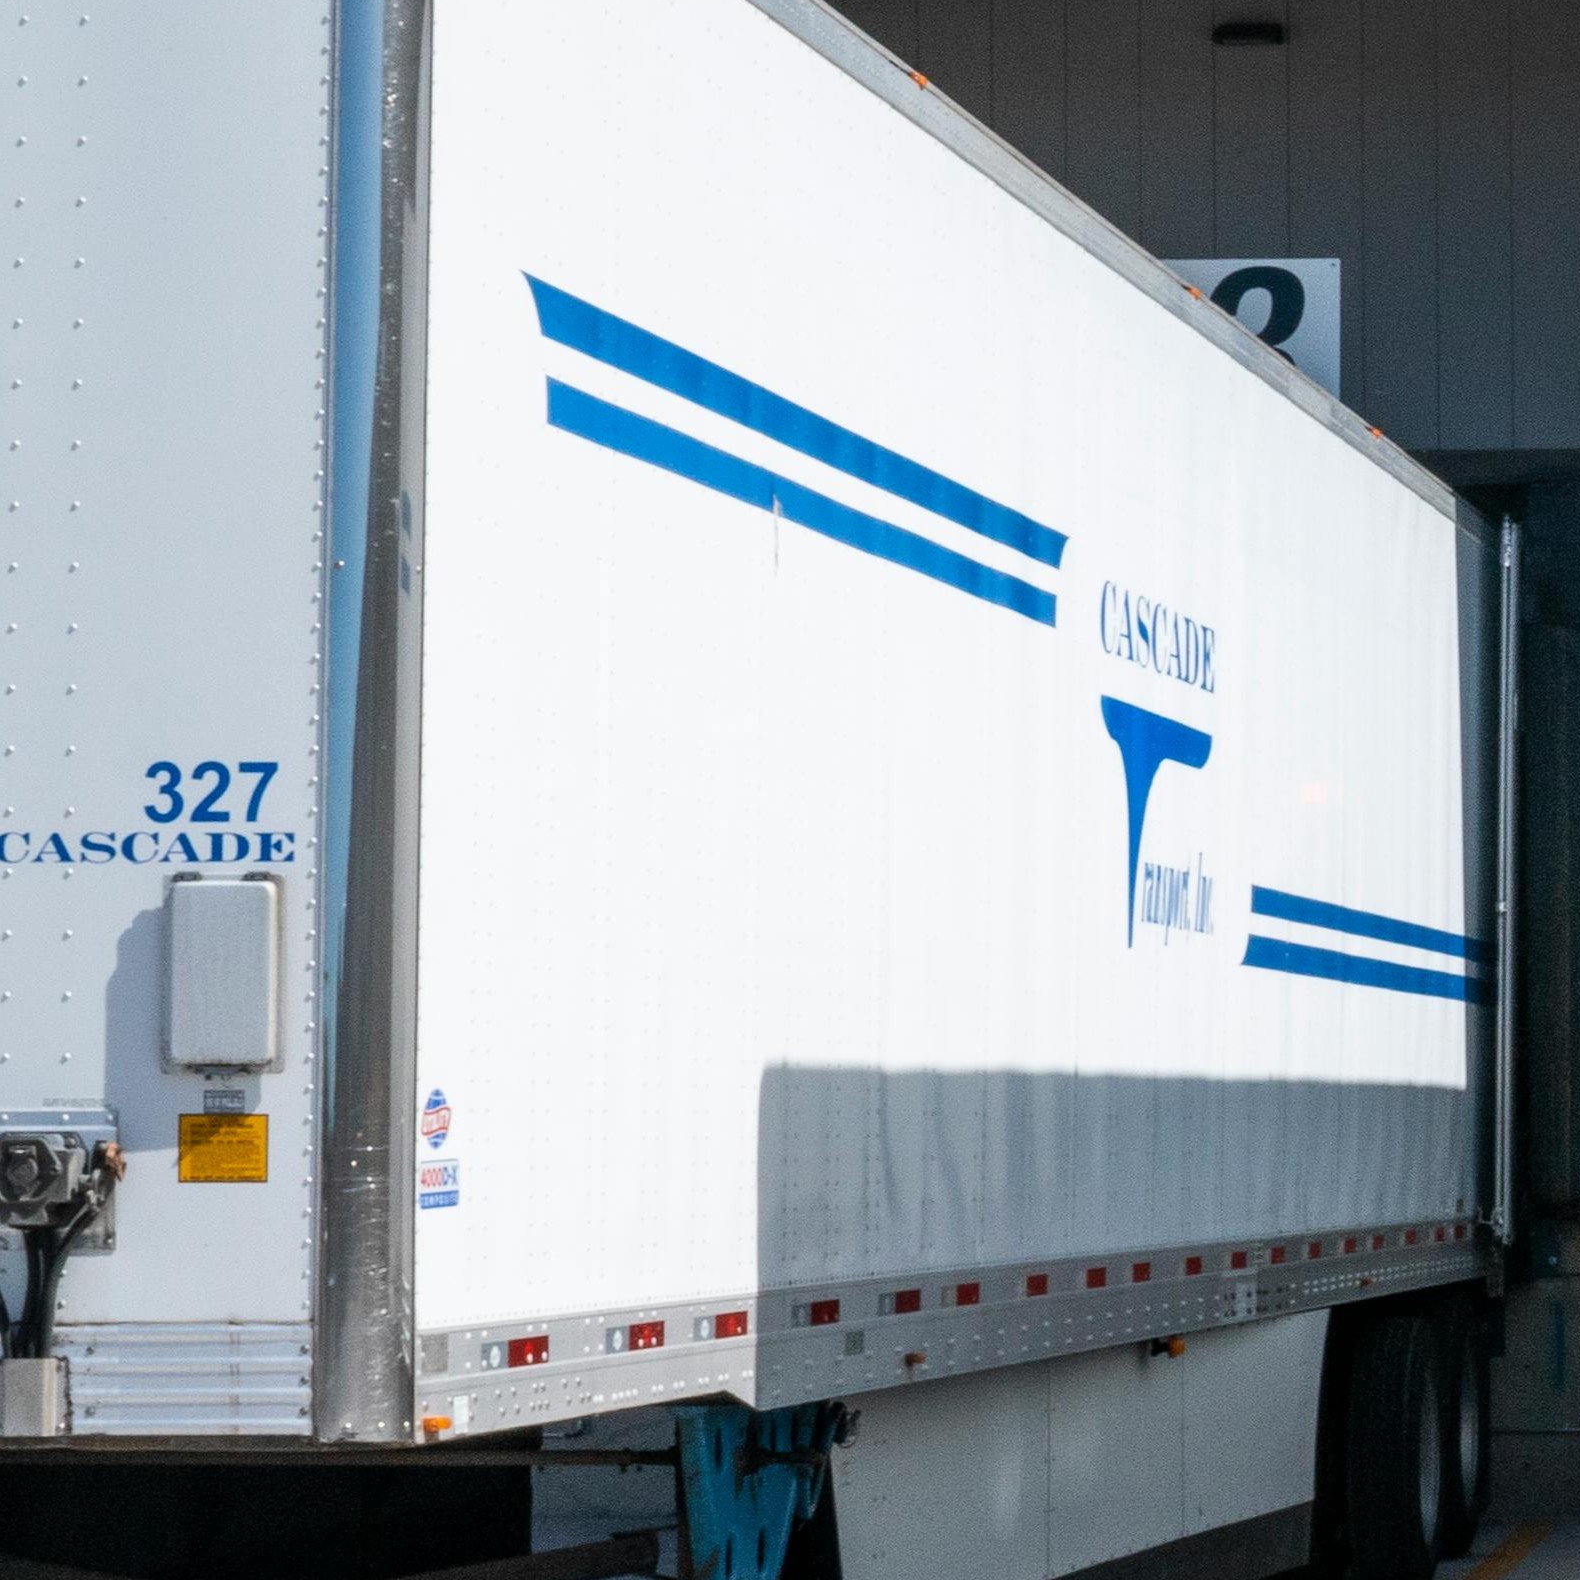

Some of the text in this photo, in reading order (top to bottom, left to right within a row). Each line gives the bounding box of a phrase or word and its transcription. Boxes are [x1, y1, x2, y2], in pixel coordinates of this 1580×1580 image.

[1100, 580, 1215, 693] CASCADE
[144, 761, 278, 823] 327
[0, 832, 295, 863] CASCADE
